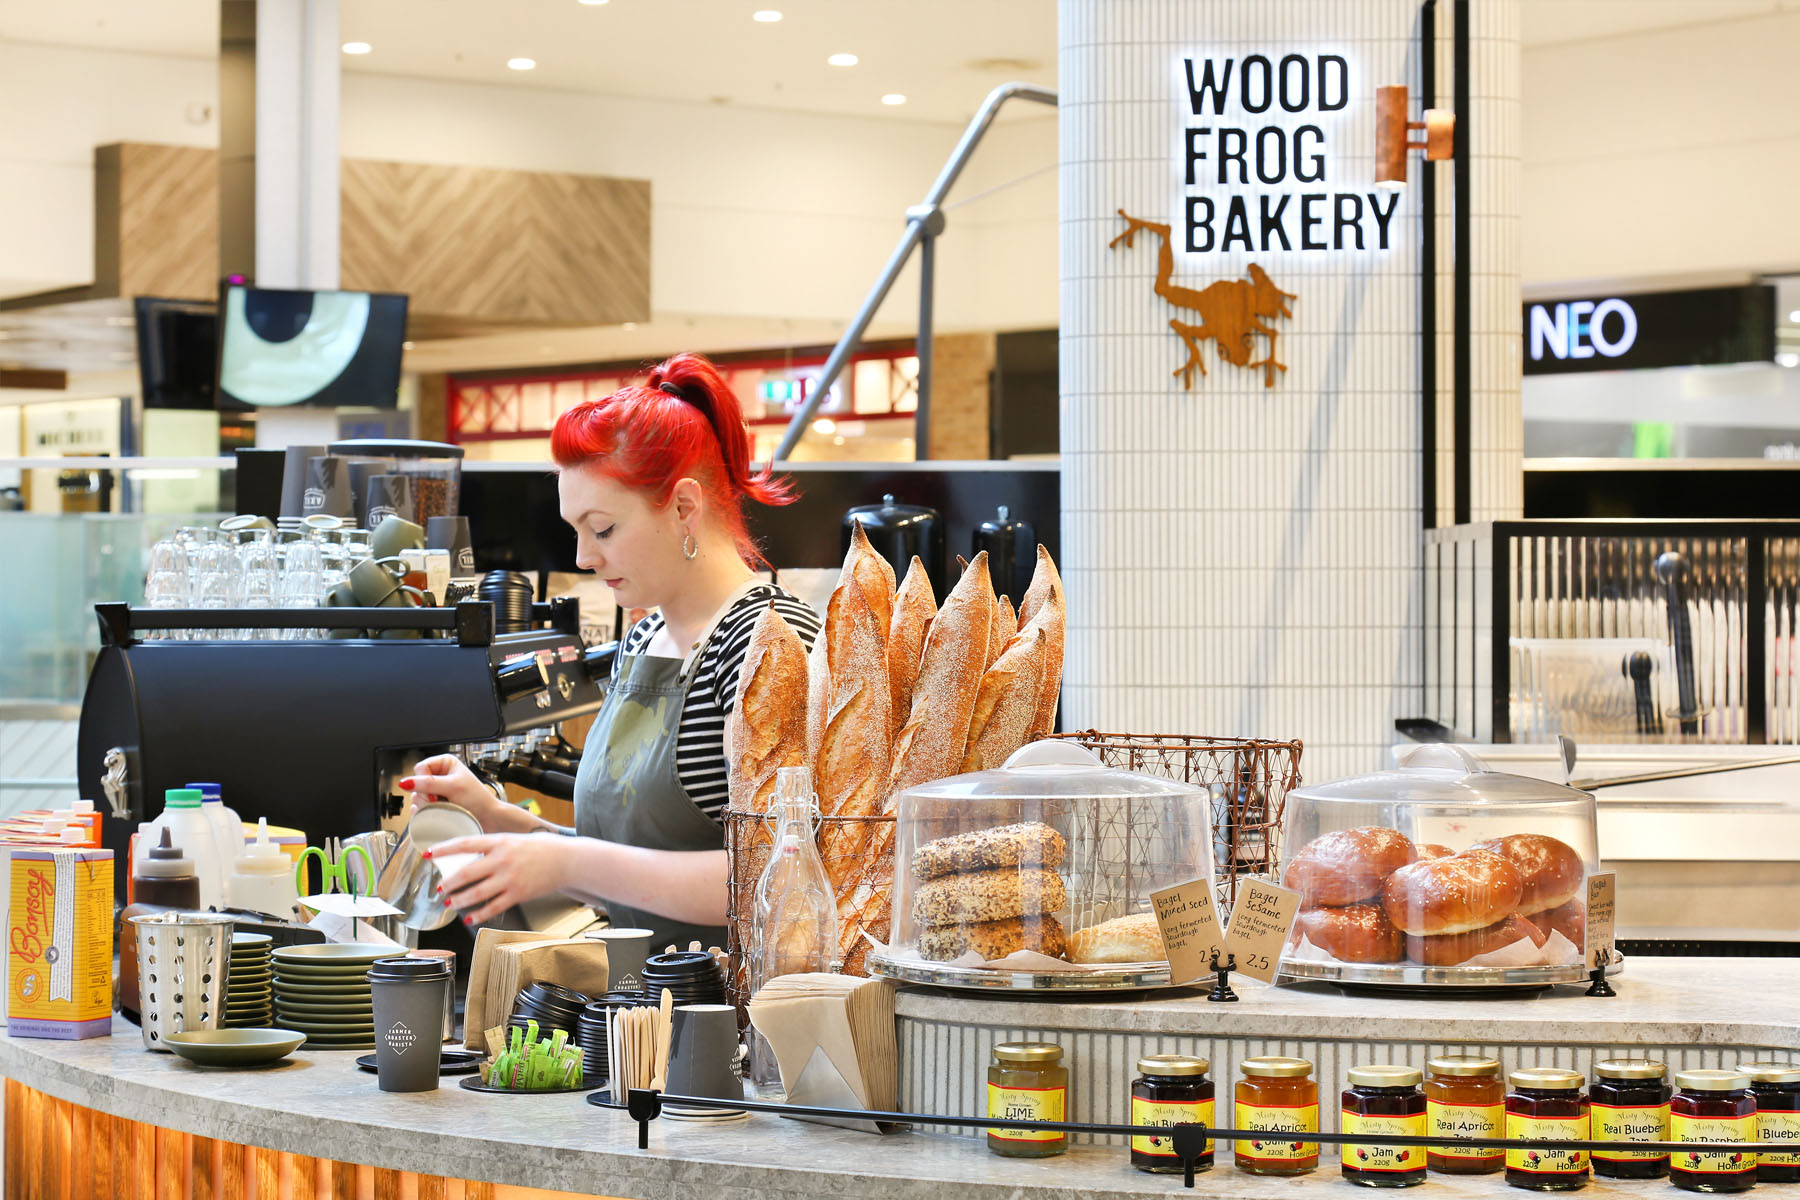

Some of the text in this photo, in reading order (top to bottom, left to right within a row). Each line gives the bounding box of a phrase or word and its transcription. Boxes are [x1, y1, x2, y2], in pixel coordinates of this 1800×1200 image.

[1184, 54, 1348, 115] WOOD
[1185, 124, 1325, 185] FROG
[1185, 192, 1400, 253] BAKERY
[1530, 298, 1638, 360] NEO
[1157, 893, 1181, 909] Bagel
[1249, 888, 1278, 906] Bagel
[9, 868, 54, 963] Bonsoy
[1160, 897, 1209, 921] Mixed Seed
[1179, 915, 1212, 930] fermented
[1253, 914, 1286, 934] fermented
[1200, 945, 1221, 963] 2.5
[1246, 953, 1270, 970] 2.5
[1005, 1107, 1035, 1118] LIME
[1249, 1121, 1268, 1131] Real
[1436, 1118, 1495, 1131] Real Apricot
[1603, 1123, 1622, 1134] Real
[1372, 1147, 1394, 1157] Jam
[1544, 1149, 1566, 1158] Jam
[1523, 1160, 1539, 1169] 220g
[1557, 1162, 1579, 1170] Home
[1684, 1160, 1699, 1169] 220g
[1717, 1162, 1741, 1170] Home
